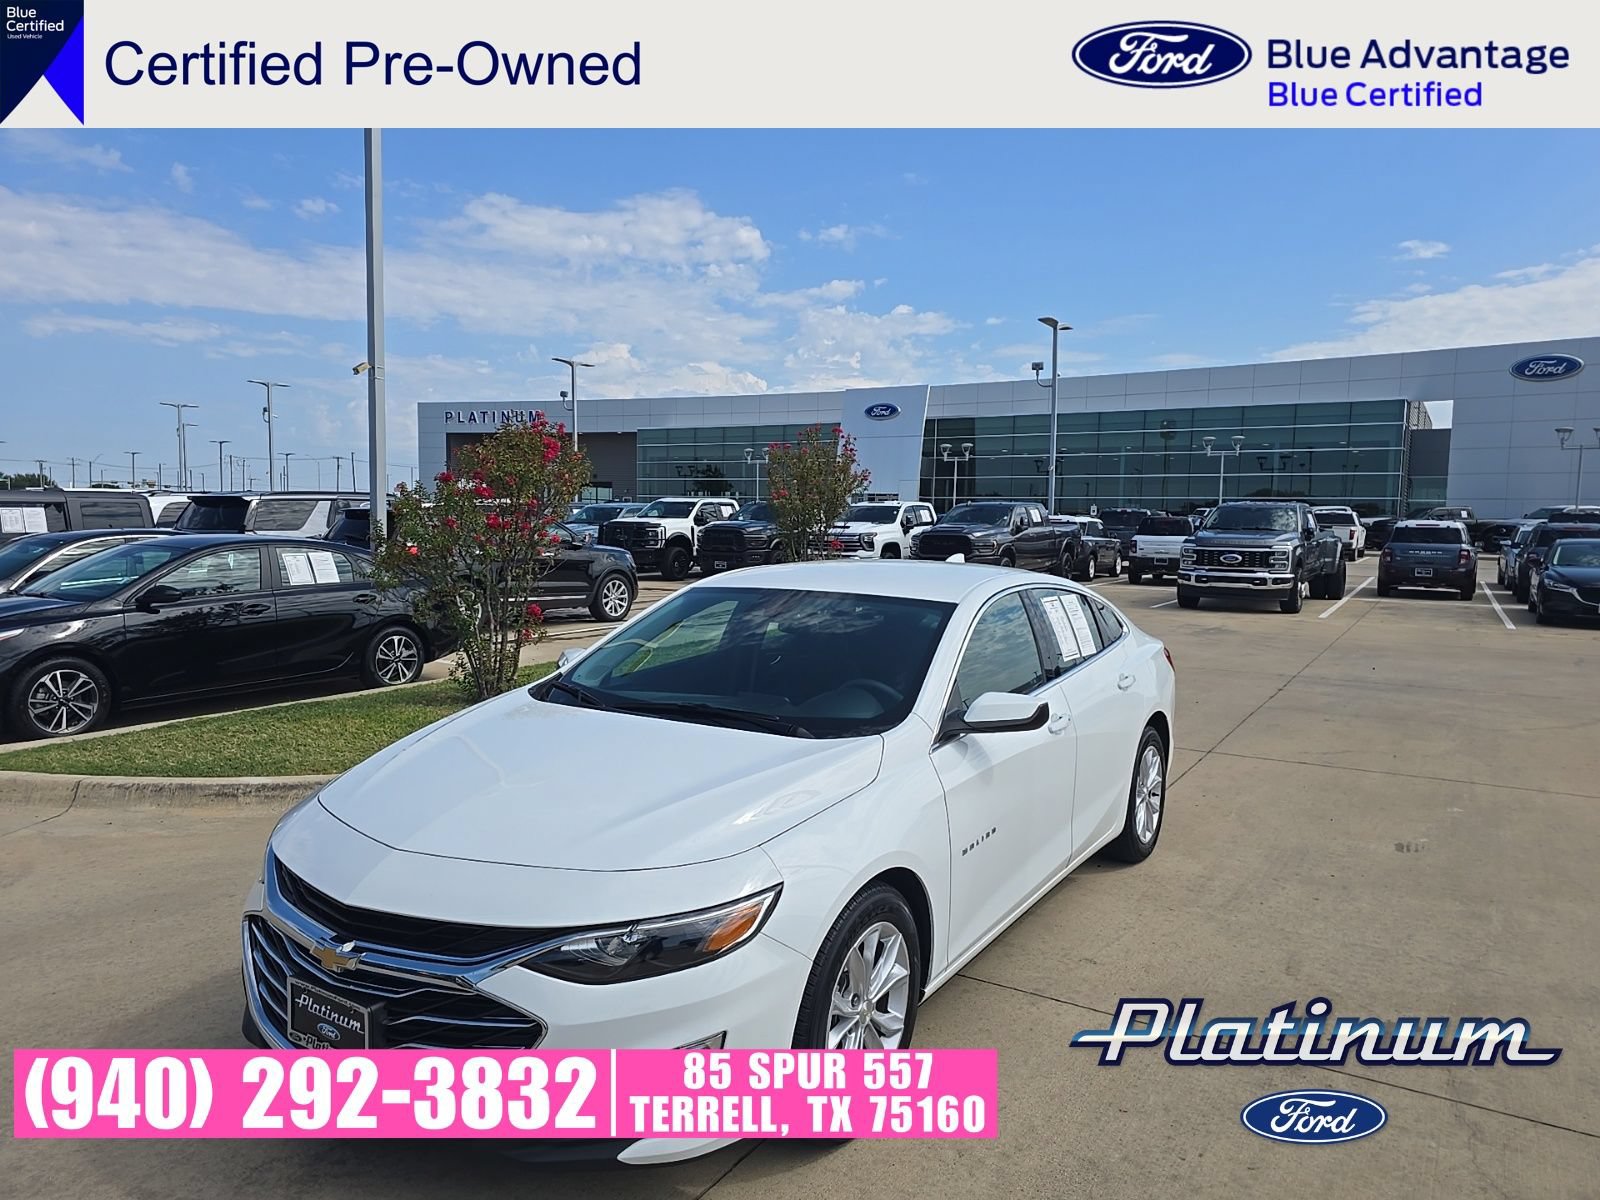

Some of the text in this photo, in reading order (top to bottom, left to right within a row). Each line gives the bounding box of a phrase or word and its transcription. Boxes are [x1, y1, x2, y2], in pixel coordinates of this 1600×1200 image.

[1524, 359, 1568, 376] Ford
[443, 409, 543, 424] PLATINUM
[294, 993, 365, 1035] Platinum
